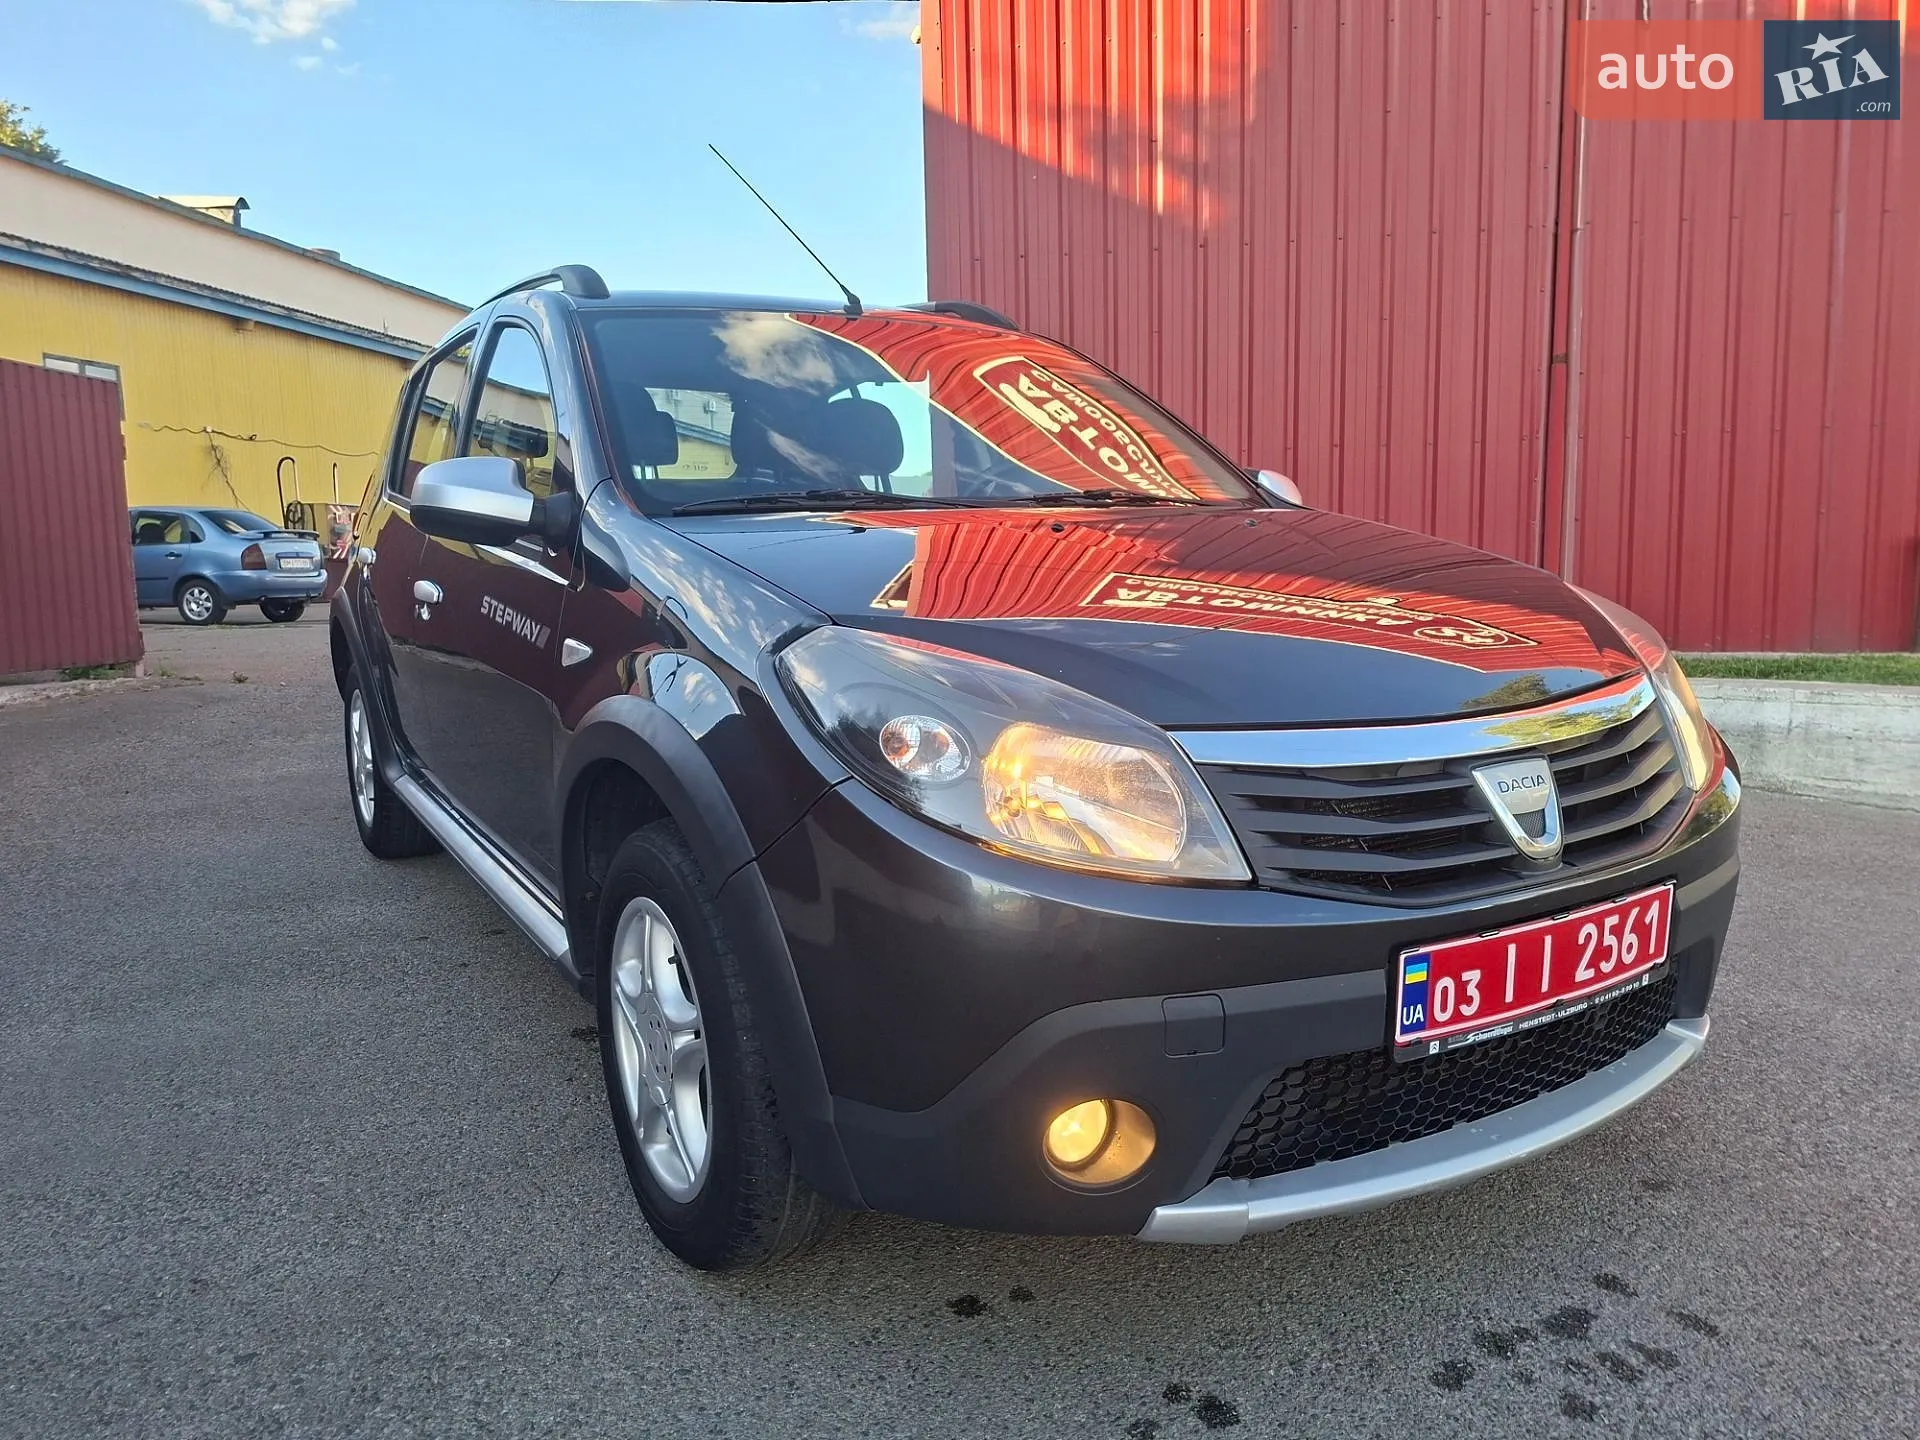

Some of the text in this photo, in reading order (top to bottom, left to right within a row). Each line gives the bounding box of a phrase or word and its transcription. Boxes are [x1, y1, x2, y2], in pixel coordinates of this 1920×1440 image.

[480, 595, 541, 643] STEPWAY
[1497, 774, 1548, 794] DACIA
[1433, 968, 1482, 1023] 03
[1574, 899, 1661, 983] 2561
[1402, 1003, 1425, 1026] UA
